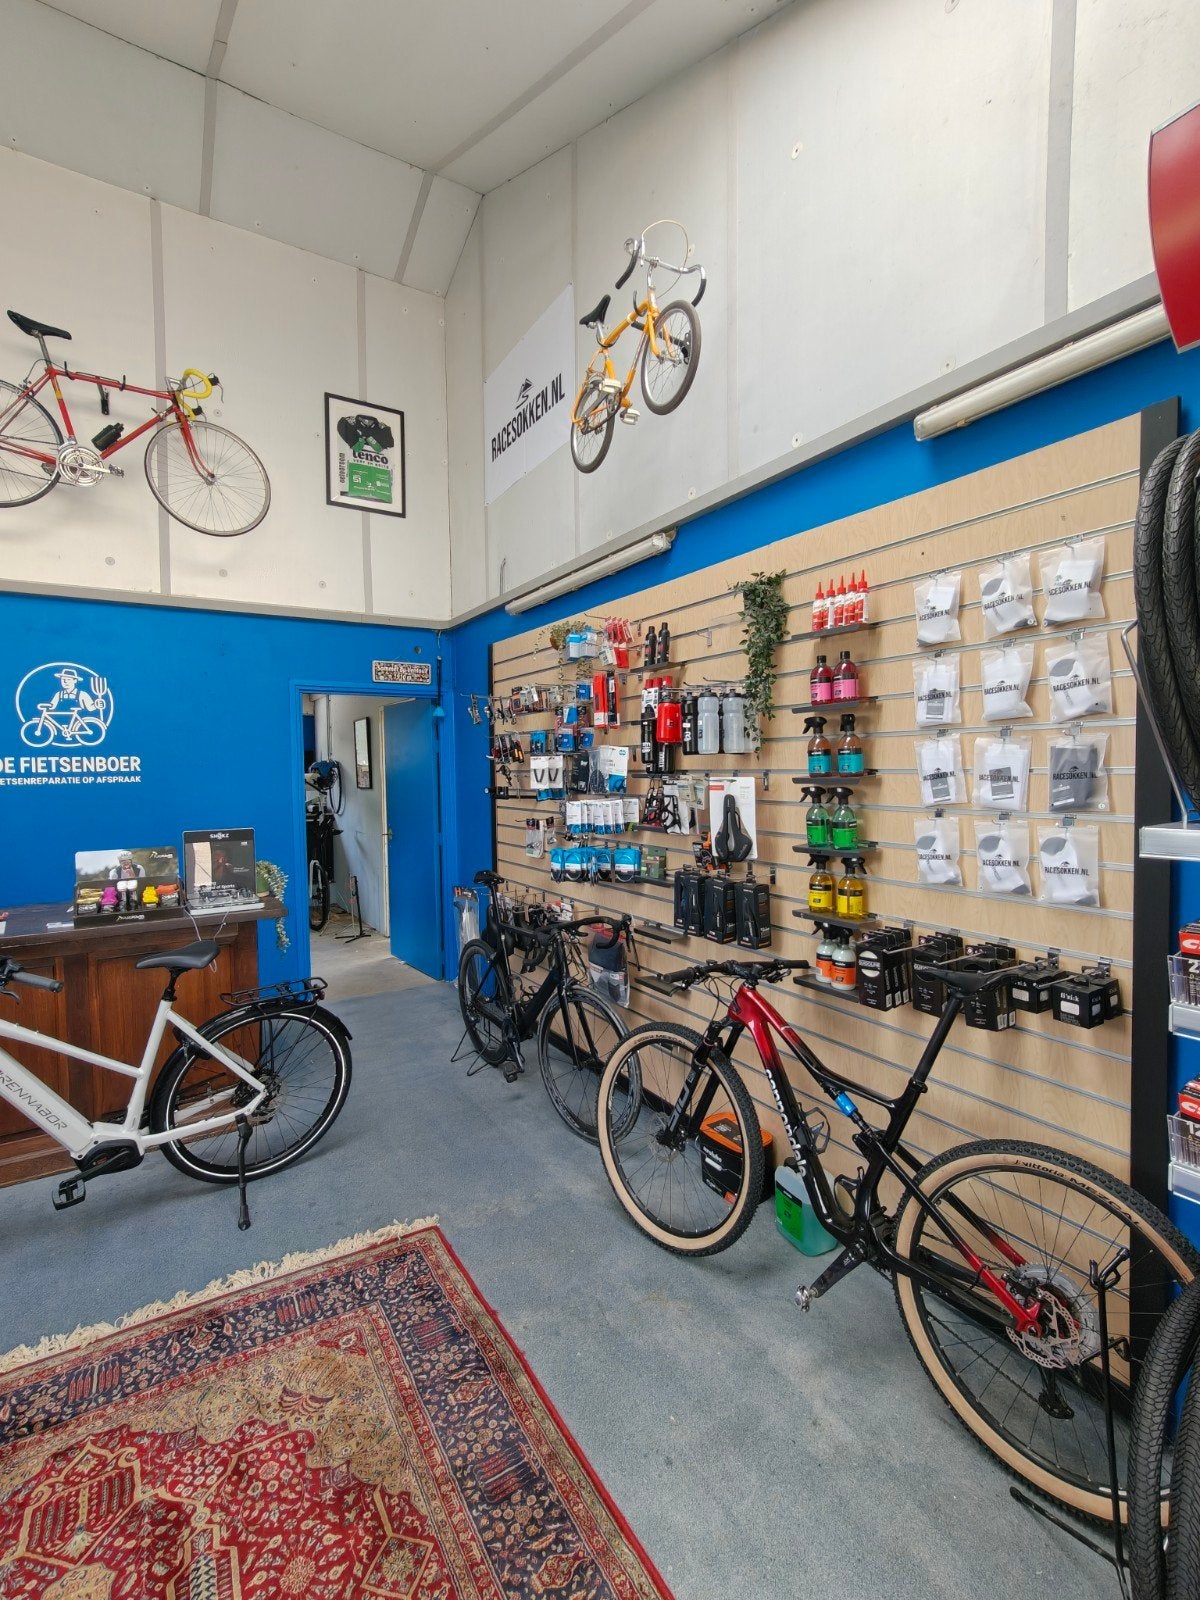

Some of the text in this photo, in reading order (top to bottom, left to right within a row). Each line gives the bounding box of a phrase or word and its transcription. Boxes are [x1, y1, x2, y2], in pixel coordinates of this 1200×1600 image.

[491, 373, 565, 463] RACESOKKEN.NL
[352, 449, 389, 465] tenco
[984, 682, 1021, 696] RACESOKKEN.NL
[1052, 676, 1101, 693] RACESOKKEN.NL
[20, 756, 141, 773] FIETSENBOER
[82, 776, 95, 784] OP
[96, 775, 141, 784] AFSPRAAK
[765, 1068, 807, 1178] cannondale
[1023, 1160, 1140, 1226] vittoria MEZCAL
